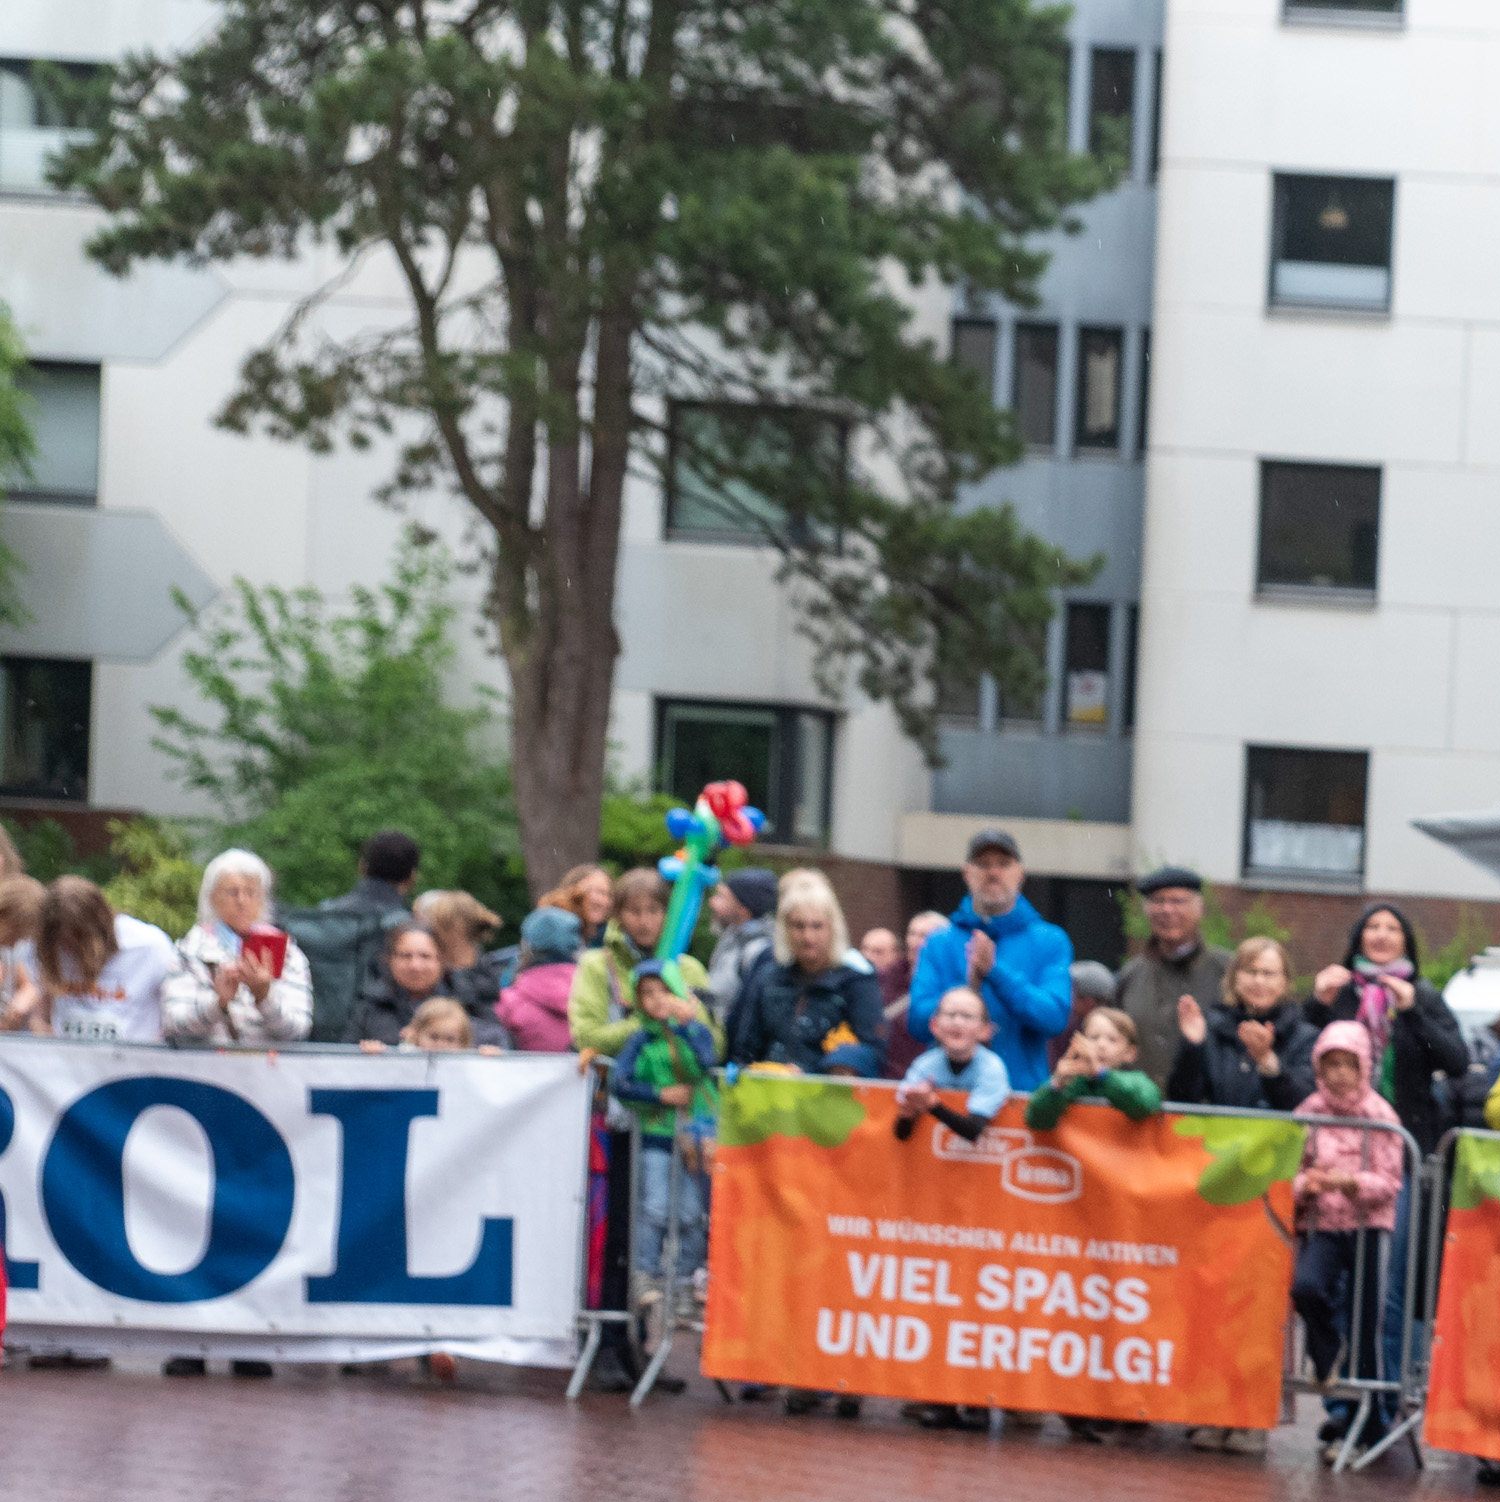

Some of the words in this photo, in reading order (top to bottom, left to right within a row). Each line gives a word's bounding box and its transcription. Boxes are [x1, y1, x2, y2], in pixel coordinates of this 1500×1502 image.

[0, 1075, 514, 1307] OL
[826, 1213, 873, 1239] WIR
[1010, 1231, 1081, 1259] ALLEN
[847, 1250, 963, 1307] VIEL
[975, 1263, 1151, 1324] SPASS
[816, 1307, 932, 1362] UND
[946, 1319, 1175, 1386] ERFOLG!
